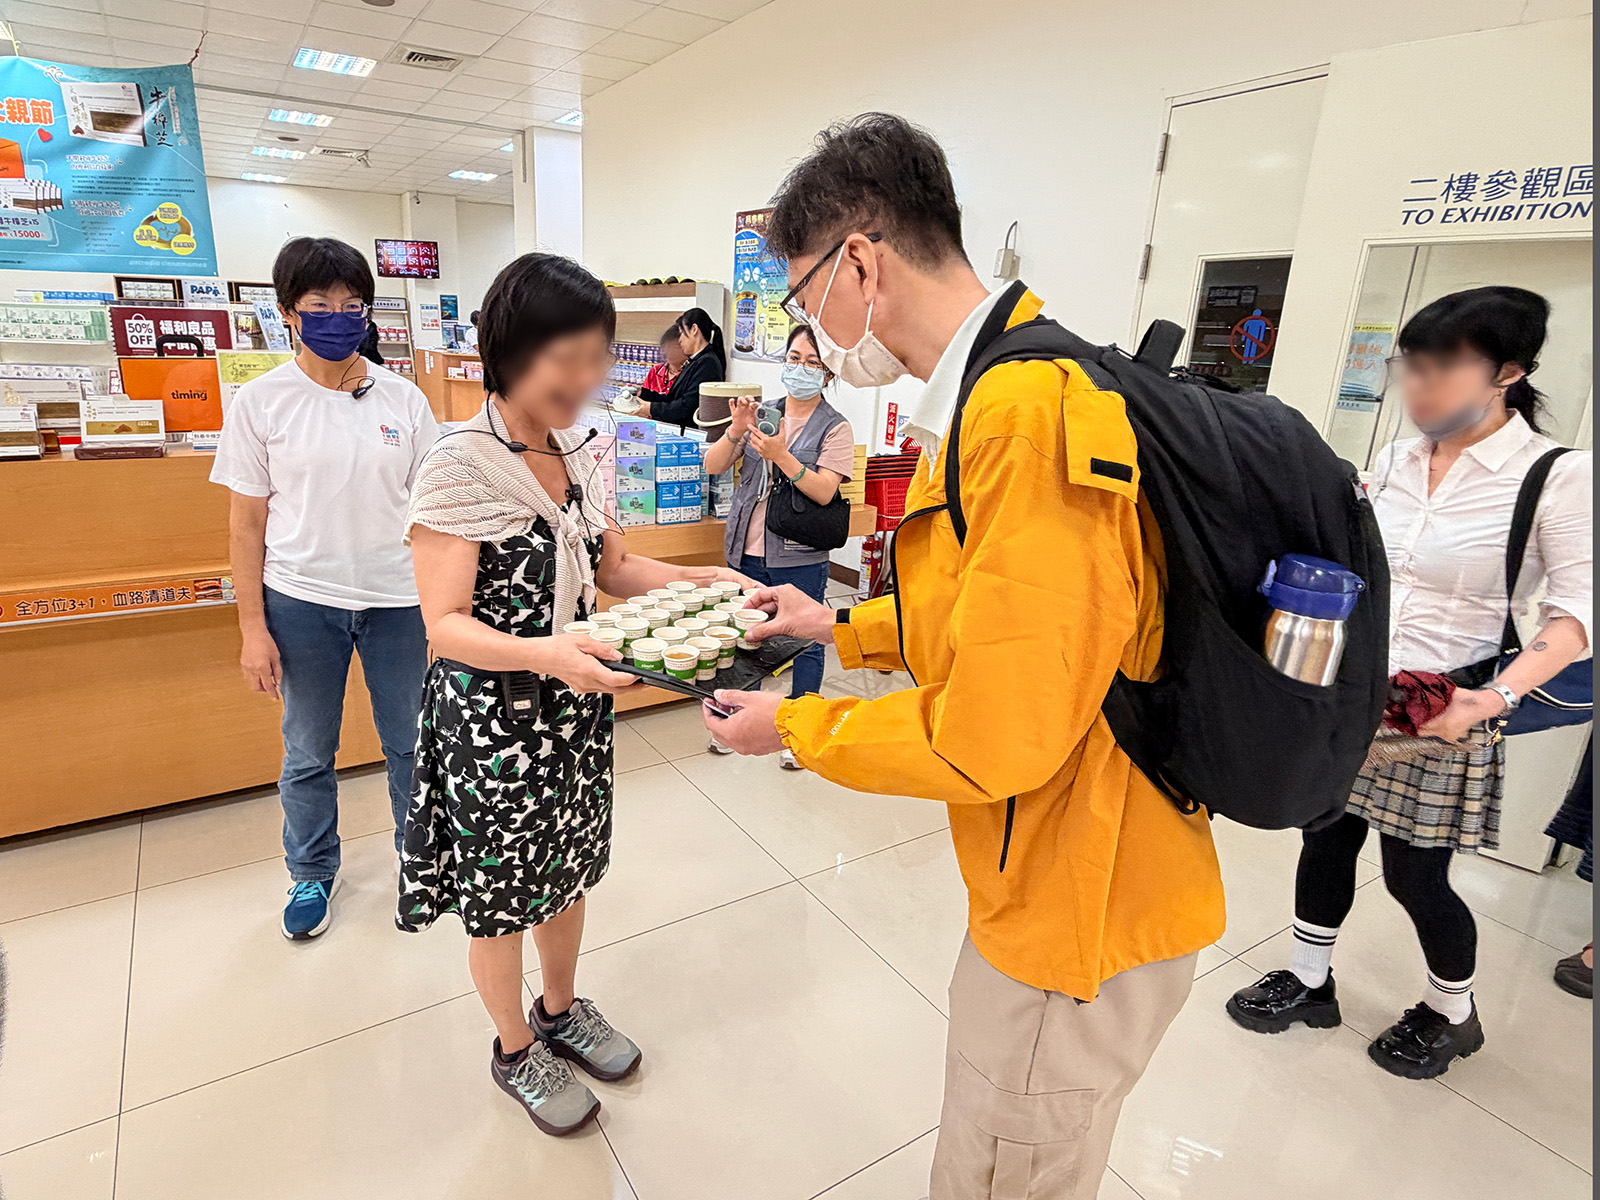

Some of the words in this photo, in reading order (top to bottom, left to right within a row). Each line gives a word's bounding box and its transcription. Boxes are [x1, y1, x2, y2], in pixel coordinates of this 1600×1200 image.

[1403, 165, 1593, 204] 二樓參觀區
[1402, 209, 1435, 226] TO
[1440, 201, 1593, 224] EXHIBITION
[128, 322, 153, 334] 50%
[159, 320, 215, 335] 福利良品
[130, 335, 153, 345] OFF
[171, 390, 208, 401] timing
